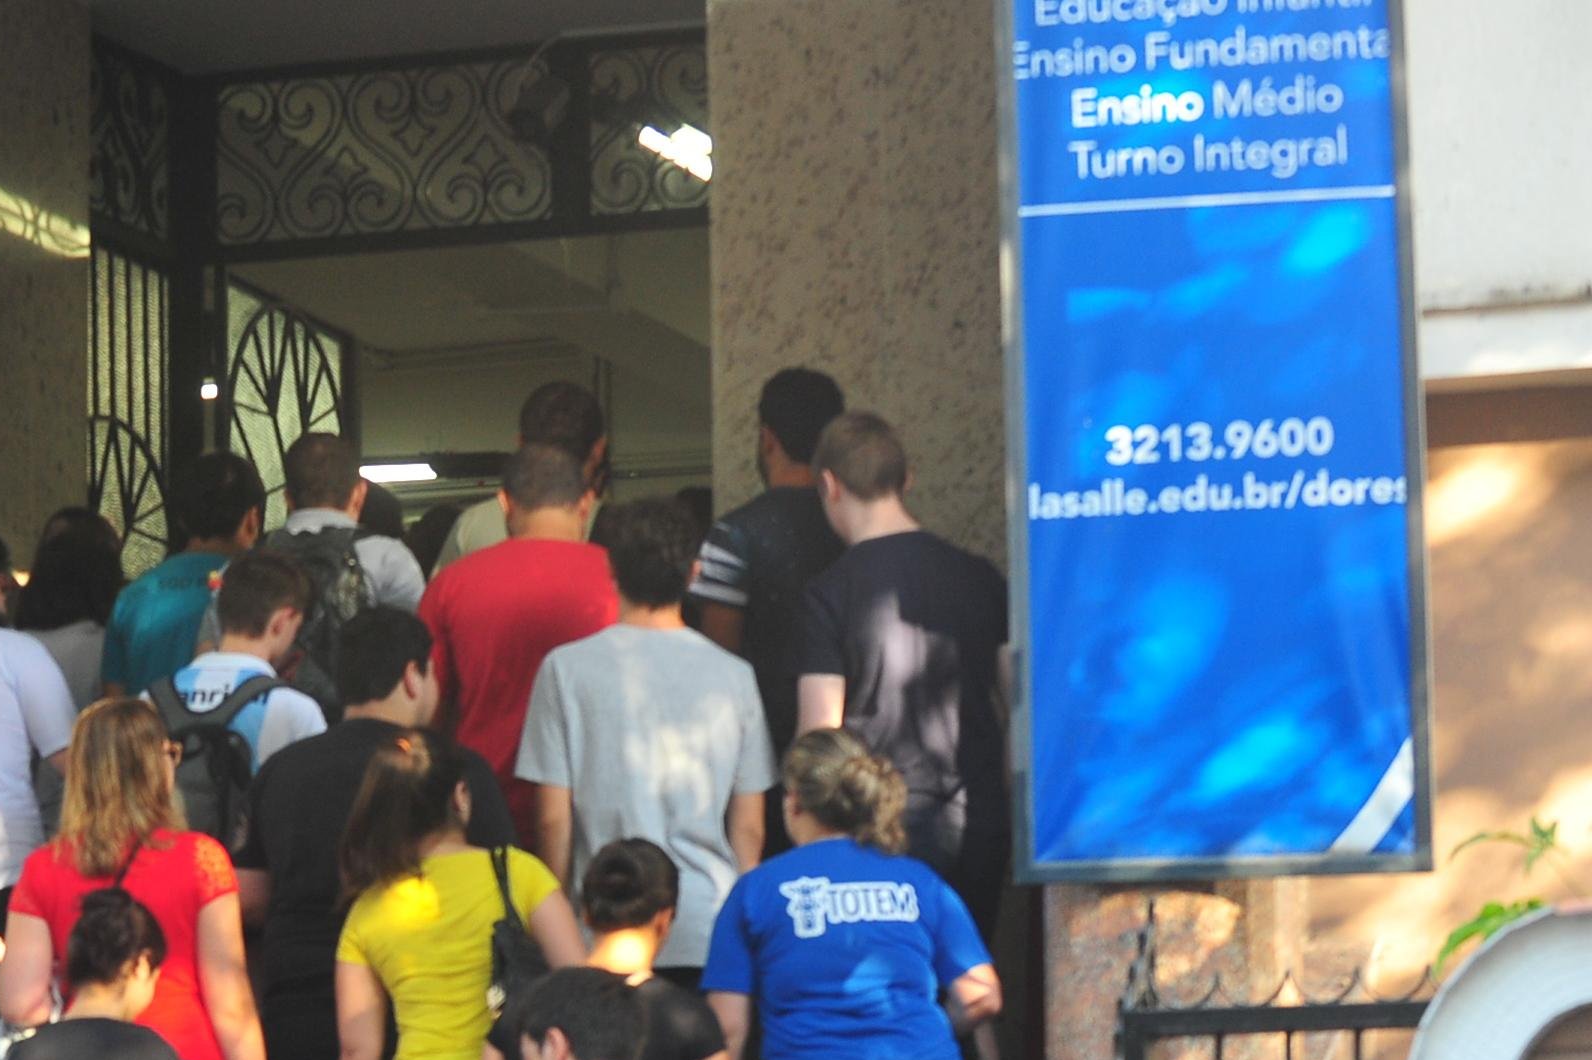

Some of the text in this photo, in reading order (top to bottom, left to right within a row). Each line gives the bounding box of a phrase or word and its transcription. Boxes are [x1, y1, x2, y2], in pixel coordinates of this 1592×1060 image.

[1013, 37, 1138, 80] Ensino
[1070, 73, 1345, 128] Ensino Médio
[1068, 122, 1348, 179] Turno Integral
[1105, 416, 1334, 466] 3213.9600
[826, 886, 915, 919] TOTEM
